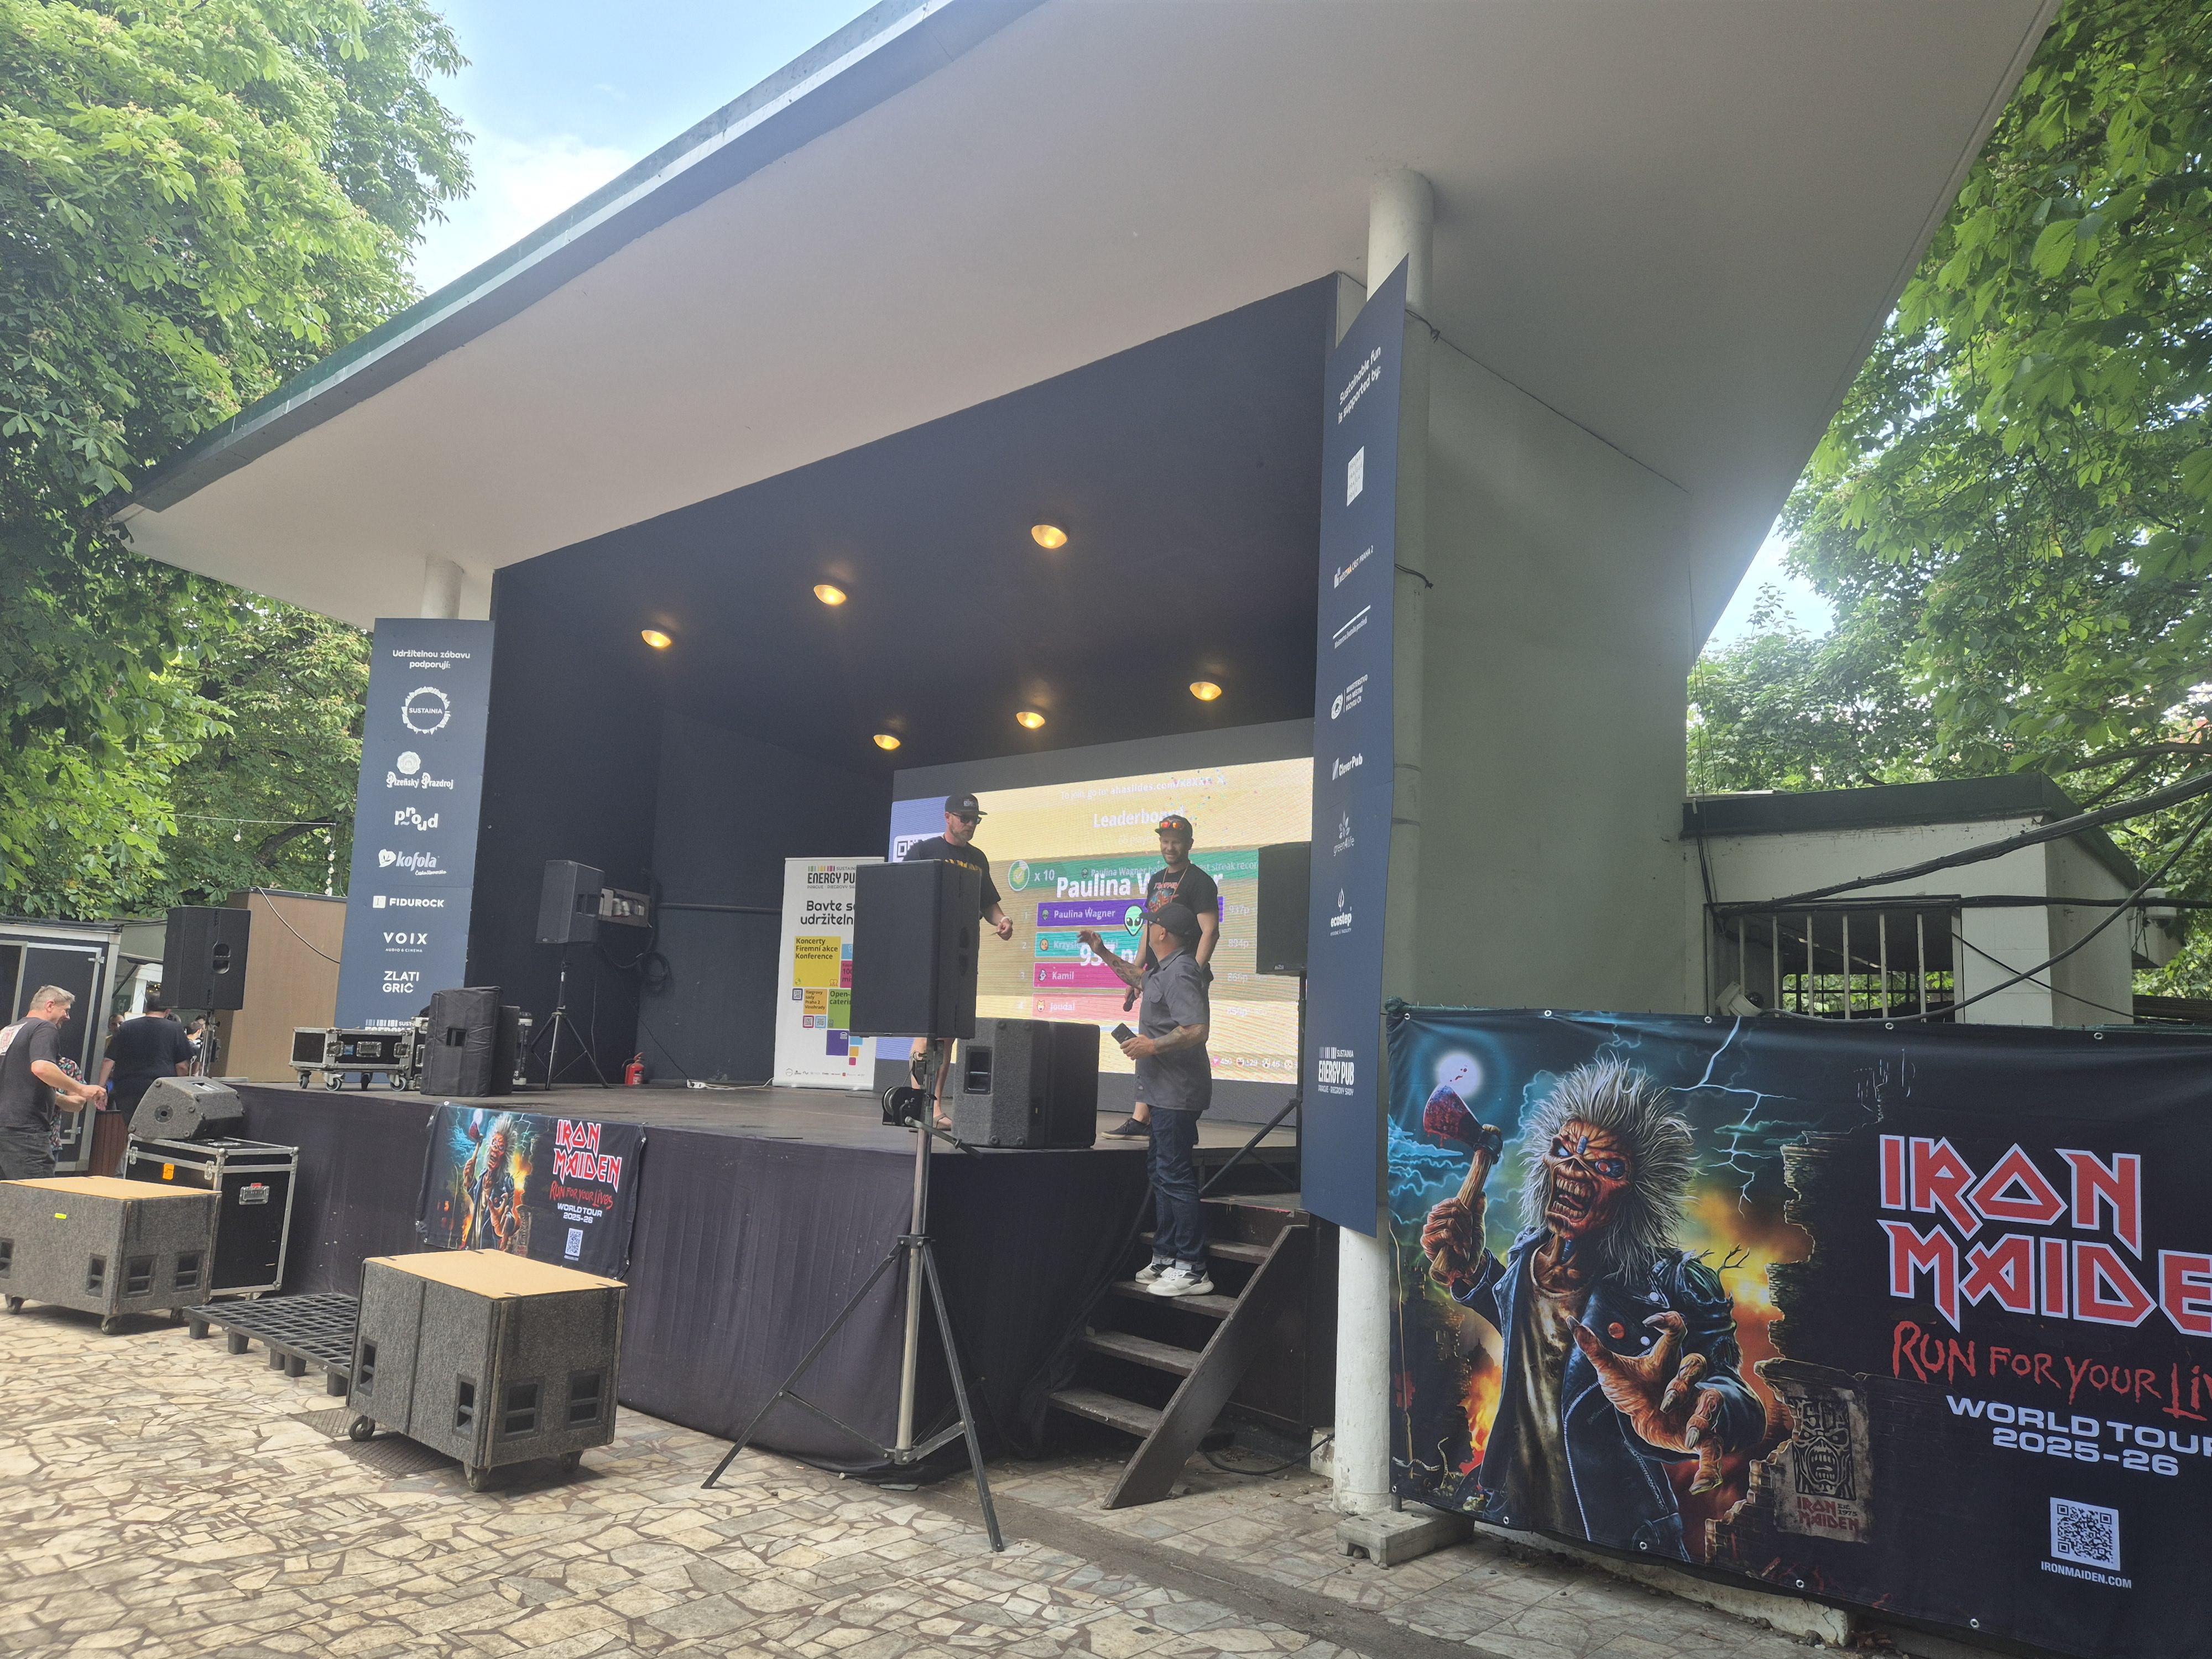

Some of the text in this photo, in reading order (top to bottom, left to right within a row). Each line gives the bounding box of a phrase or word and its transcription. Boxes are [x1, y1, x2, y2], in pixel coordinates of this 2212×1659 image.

[1340, 346, 1381, 405] Sustainable fun
[1338, 366, 1381, 424] is supported by:
[393, 649, 470, 659] Udržitelnou zábavu
[421, 773, 453, 790] Prazdroj
[394, 807, 439, 831] proud
[396, 851, 437, 872] kofola
[1034, 872, 1041, 881] x
[1044, 869, 1055, 880] 10
[1237, 862, 1258, 870] recor
[807, 872, 855, 884] ENERGY PU
[1056, 873, 1131, 898] Paulina
[389, 898, 445, 907] FIDUROCK
[806, 900, 853, 911] Bavte s
[800, 913, 854, 925] udržiteln
[1054, 909, 1083, 919] Paulina
[1084, 909, 1116, 920] Wagner
[1330, 912, 1352, 927] ecostep
[383, 932, 428, 945] VOIX
[384, 971, 420, 981] ZLATI
[1052, 971, 1074, 980] Kamil
[1318, 1060, 1354, 1086] ENERGY PUB
[555, 1119, 601, 1159] IRON
[552, 1147, 622, 1193] MAIDEN
[549, 1180, 566, 1201] RUN
[1879, 1134, 2142, 1262] IRON
[557, 1203, 603, 1217] WORLD TOUR
[563, 1212, 593, 1224] 2025-26
[1876, 1218, 2212, 1338] MAIDE
[1892, 1321, 1976, 1384] RUN
[1990, 1345, 2062, 1390] FOR
[2064, 1355, 2162, 1405] YOUR
[1945, 1395, 2100, 1438] WORLD
[1992, 1427, 2179, 1477] 2025-26
[1797, 1496, 1837, 1518] IRON
[1799, 1511, 1859, 1535] MAIDEN
[2041, 1561, 2132, 1589] IRONMAIDEN.COM
